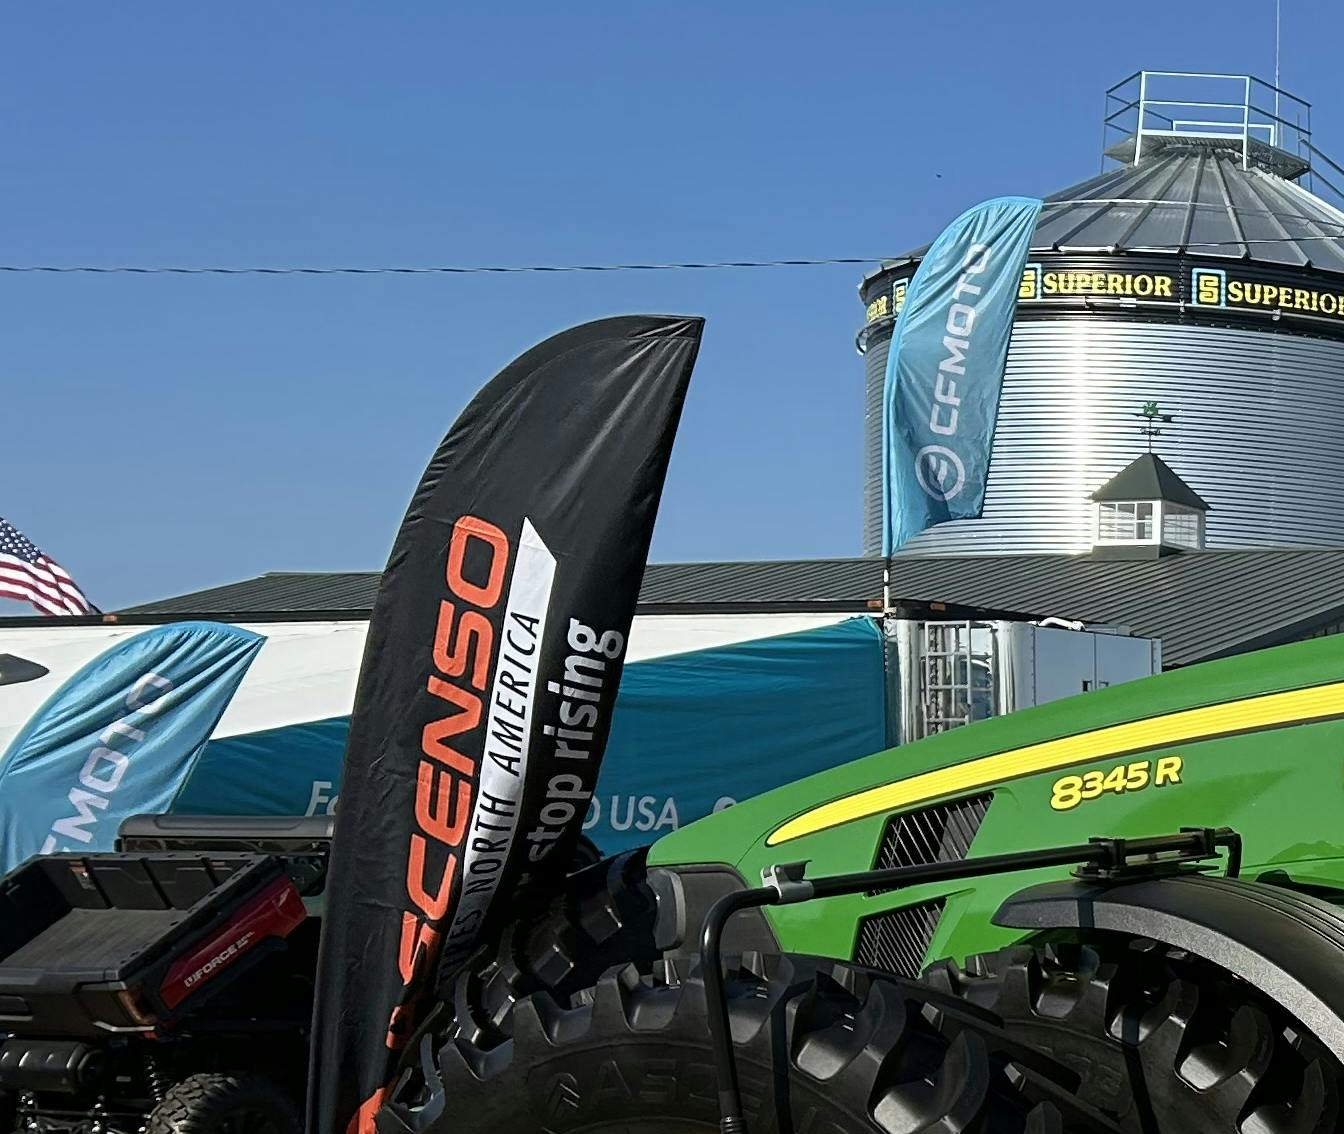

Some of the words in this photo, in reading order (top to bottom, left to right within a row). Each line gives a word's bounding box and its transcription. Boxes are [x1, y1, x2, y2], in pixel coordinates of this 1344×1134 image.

[1042, 271, 1173, 299] SUPERIOR
[929, 242, 991, 437] CFMOTO
[487, 611, 541, 778] AMERICA
[541, 616, 626, 766] rising
[384, 514, 511, 1050] SCENSO
[528, 771, 595, 864] stop
[609, 795, 680, 832] USA
[1049, 761, 1153, 812] 8345
[1154, 755, 1184, 787] R
[466, 790, 517, 896] NORTH
